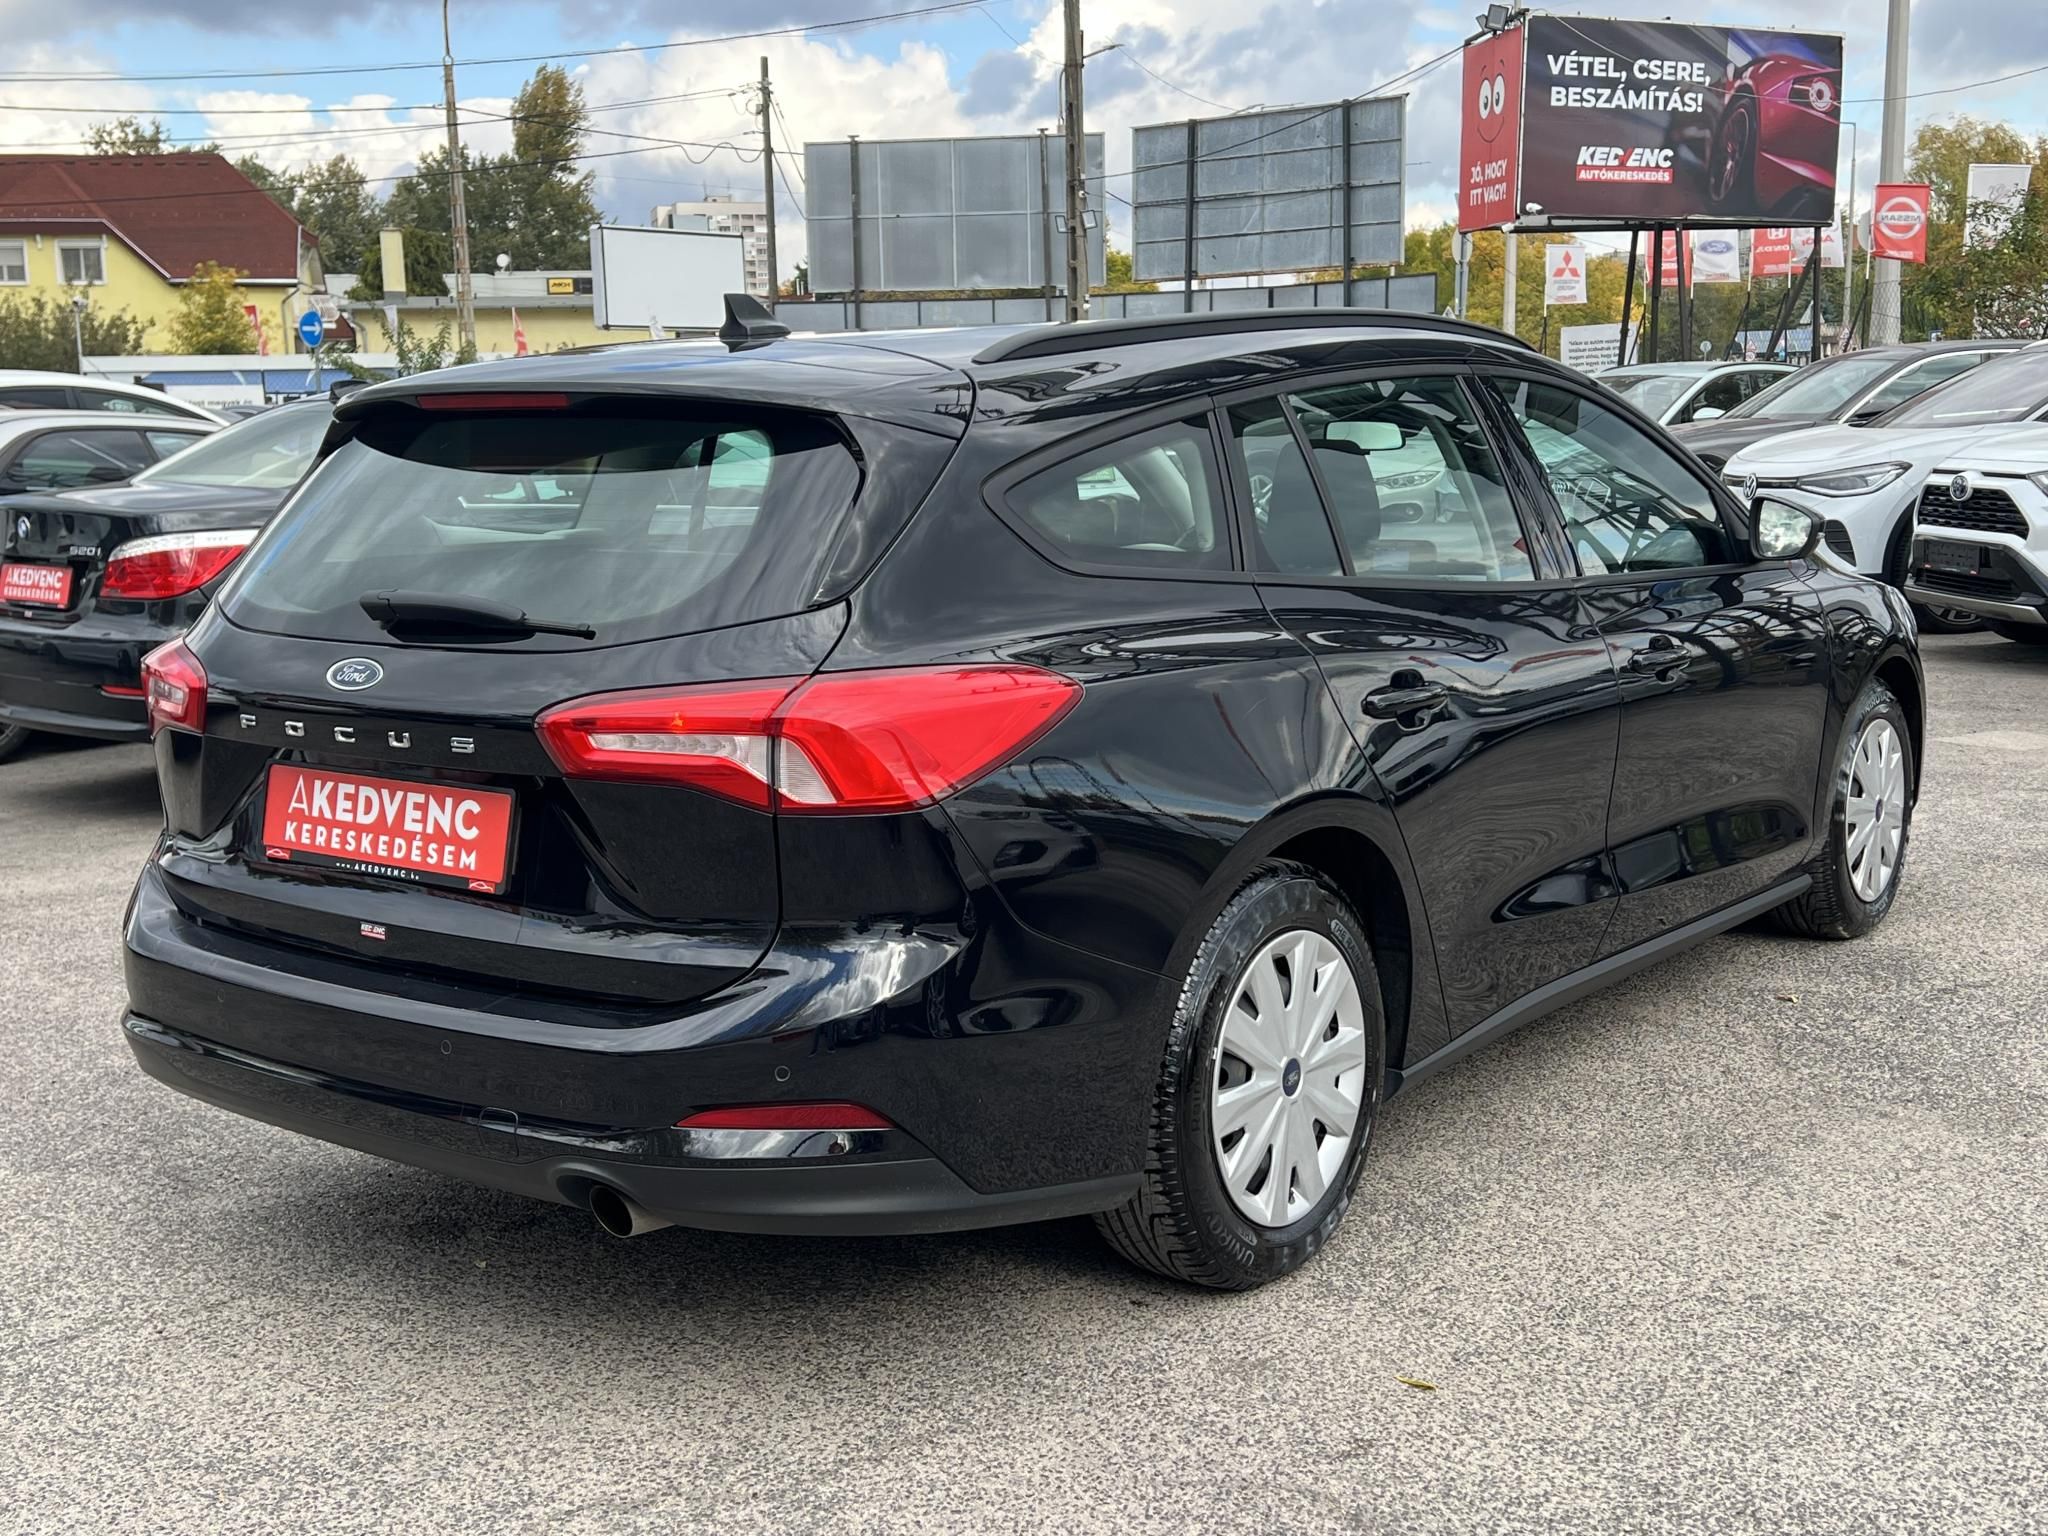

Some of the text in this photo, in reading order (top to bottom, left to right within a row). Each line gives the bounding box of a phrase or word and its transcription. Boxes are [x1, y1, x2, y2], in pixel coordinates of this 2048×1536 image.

[1546, 50, 1711, 87] VÉTEL, CSERE,
[1550, 84, 1703, 113] BESZÁMÍTÁS!
[1470, 158, 1508, 185] JÓ, HOGY
[1578, 168, 1670, 181] AUTÓKERESKEDÉS
[1469, 182, 1507, 206] ITT VAGY!
[5, 567, 63, 589] AKEDVENC
[336, 664, 371, 682] Ford
[239, 714, 475, 754] FOCUS
[287, 775, 482, 841] AKEDVENC
[284, 820, 477, 871] KERESKEDÉSEM
